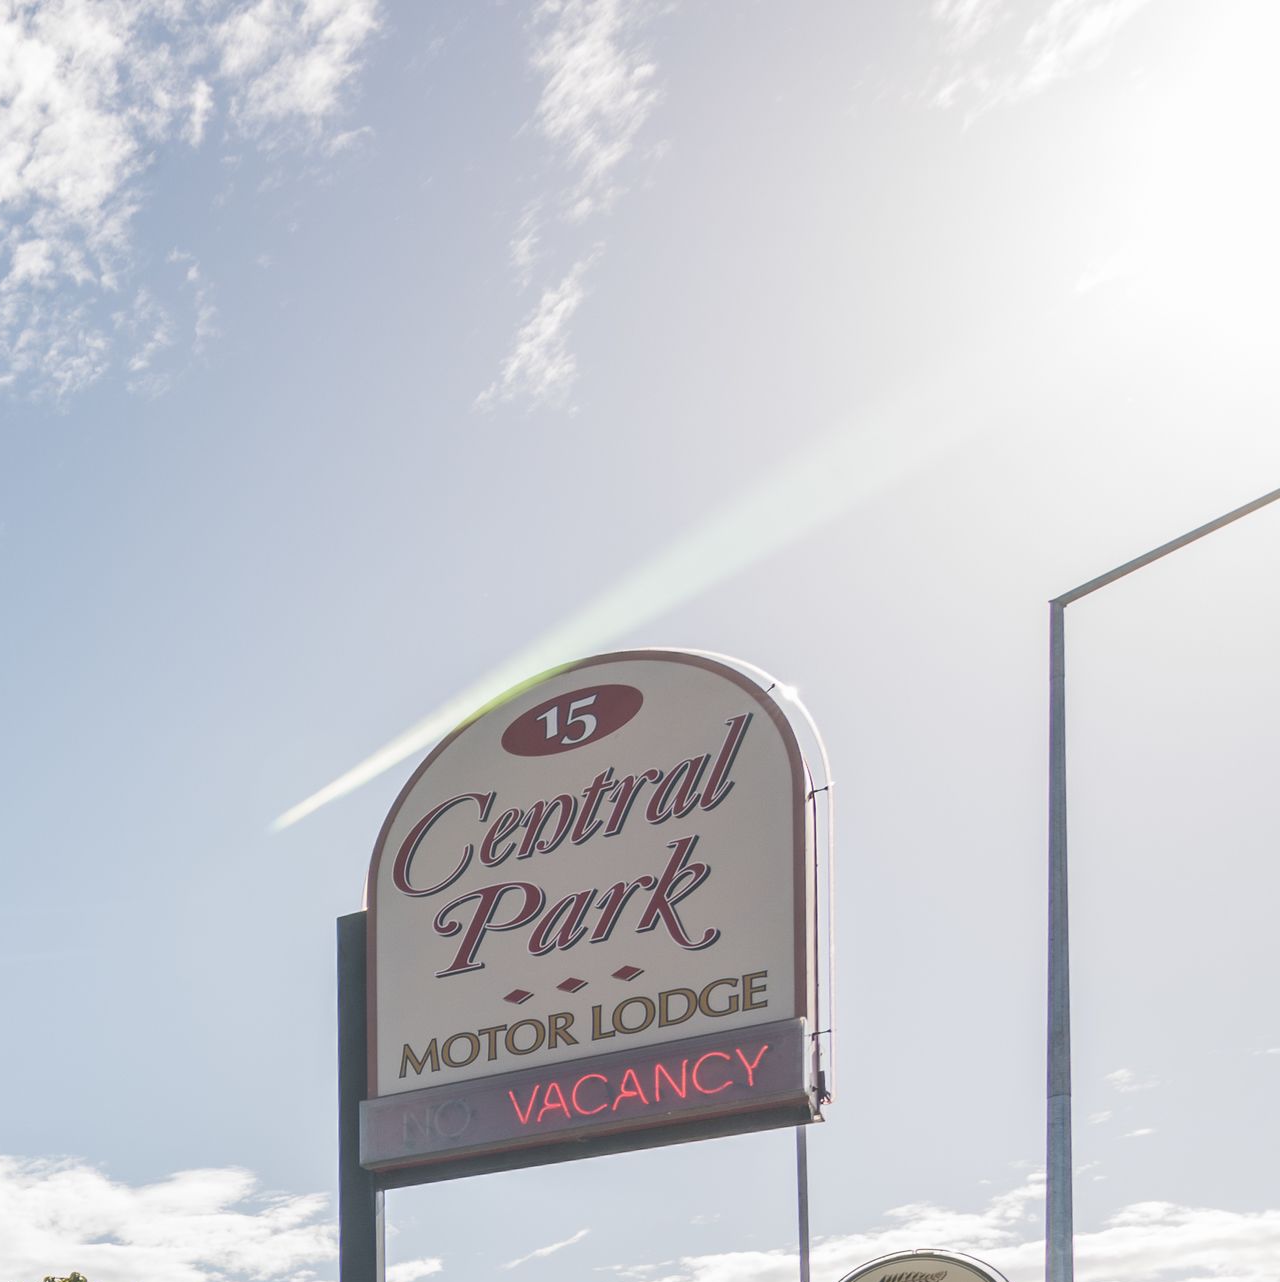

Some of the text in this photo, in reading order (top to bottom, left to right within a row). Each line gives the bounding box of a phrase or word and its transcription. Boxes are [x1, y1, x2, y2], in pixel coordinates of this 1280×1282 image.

[535, 694, 600, 745] 15
[392, 712, 755, 898] Central
[432, 835, 721, 978] Park
[398, 970, 769, 1079] MOTOR LODGE
[509, 1045, 770, 1125] VACANCY
